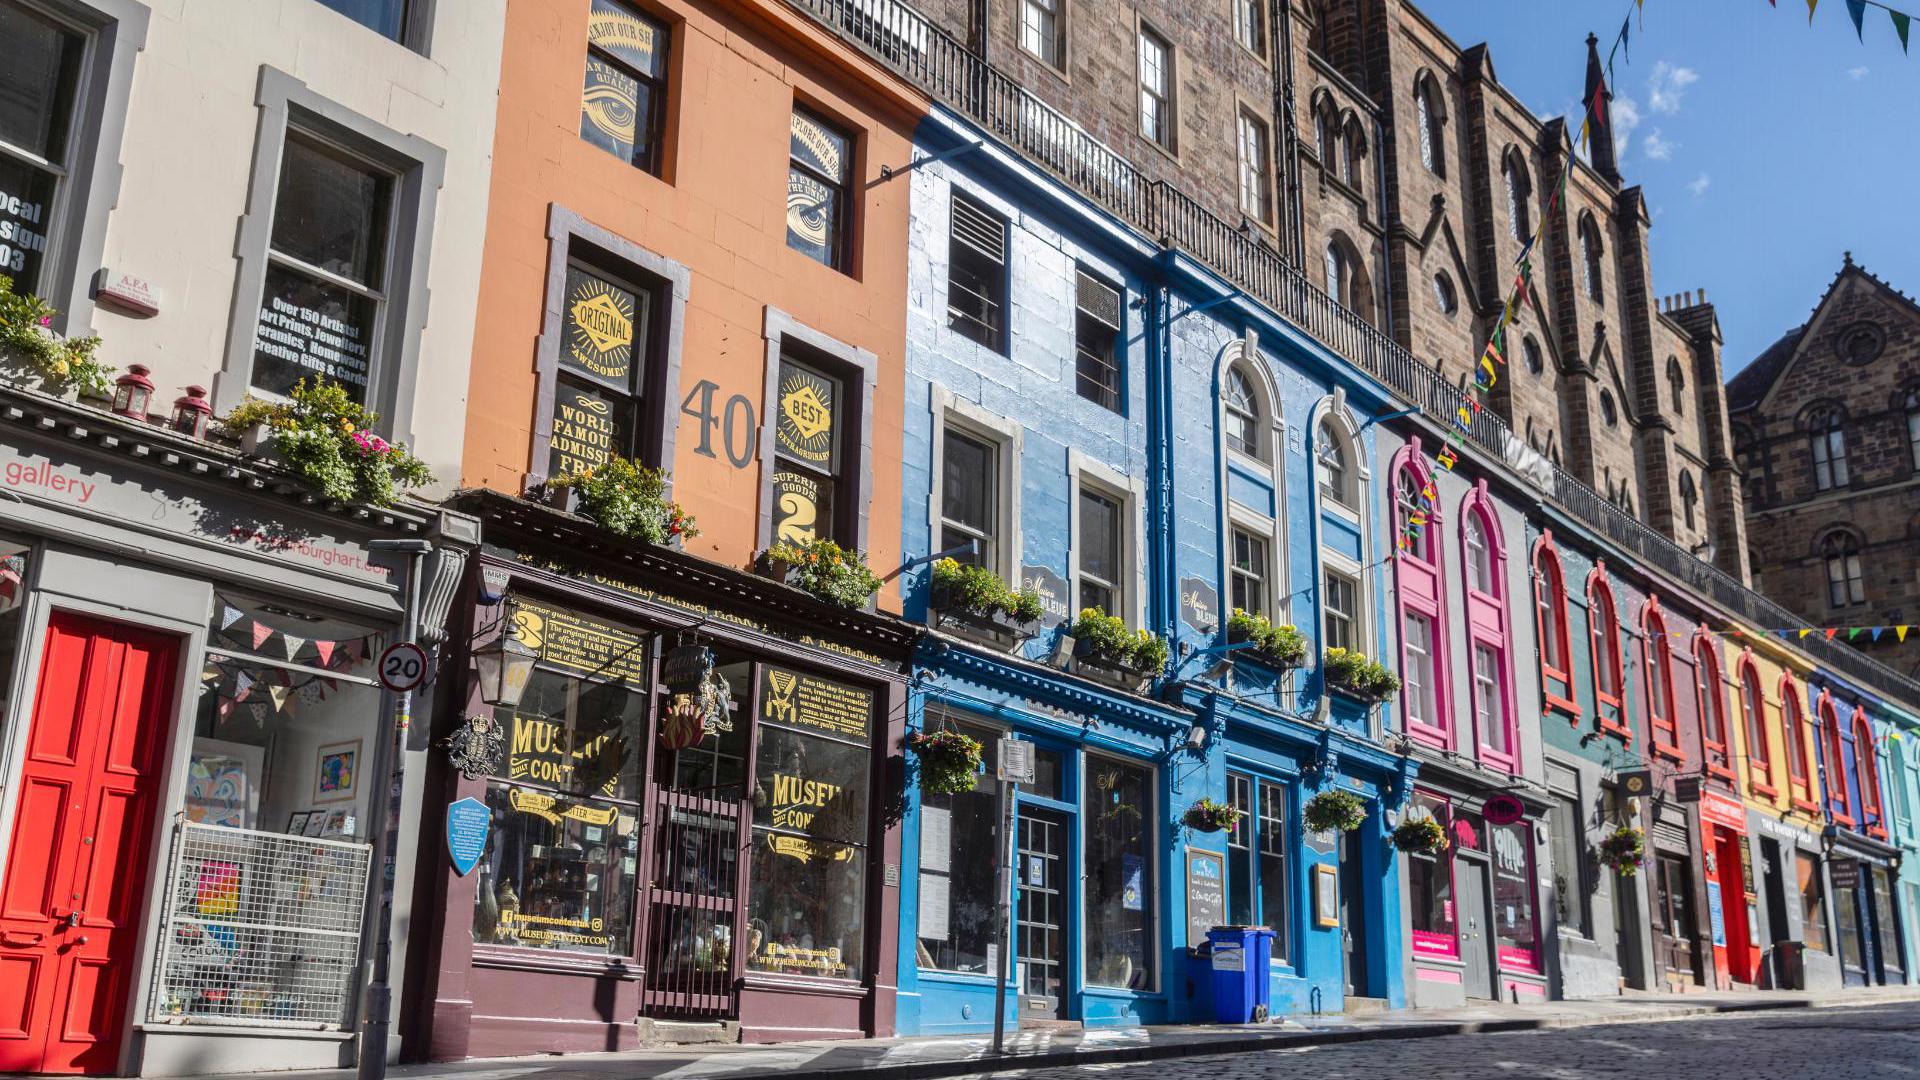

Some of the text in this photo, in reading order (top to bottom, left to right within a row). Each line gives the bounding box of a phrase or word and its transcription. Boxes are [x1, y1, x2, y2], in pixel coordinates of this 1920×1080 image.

[618, 22, 637, 40] OUR
[260, 307, 367, 358] Art Prints, Jewellery,
[272, 296, 359, 339] Over 150 Artists!
[580, 306, 628, 340] ORIGINAL
[257, 324, 367, 372] eramics, Homeware
[300, 353, 326, 372] Gifts
[327, 364, 336, 376] &
[336, 366, 368, 387] Cards
[680, 378, 756, 469] 40
[793, 400, 822, 425] BEST
[6, 462, 96, 502] gallery
[550, 623, 562, 632] The
[562, 628, 588, 640] original
[588, 634, 600, 643] and
[1196, 609, 1218, 628] BLEUE
[548, 632, 556, 640] of
[584, 642, 610, 654] HARRY
[386, 656, 420, 678] 20
